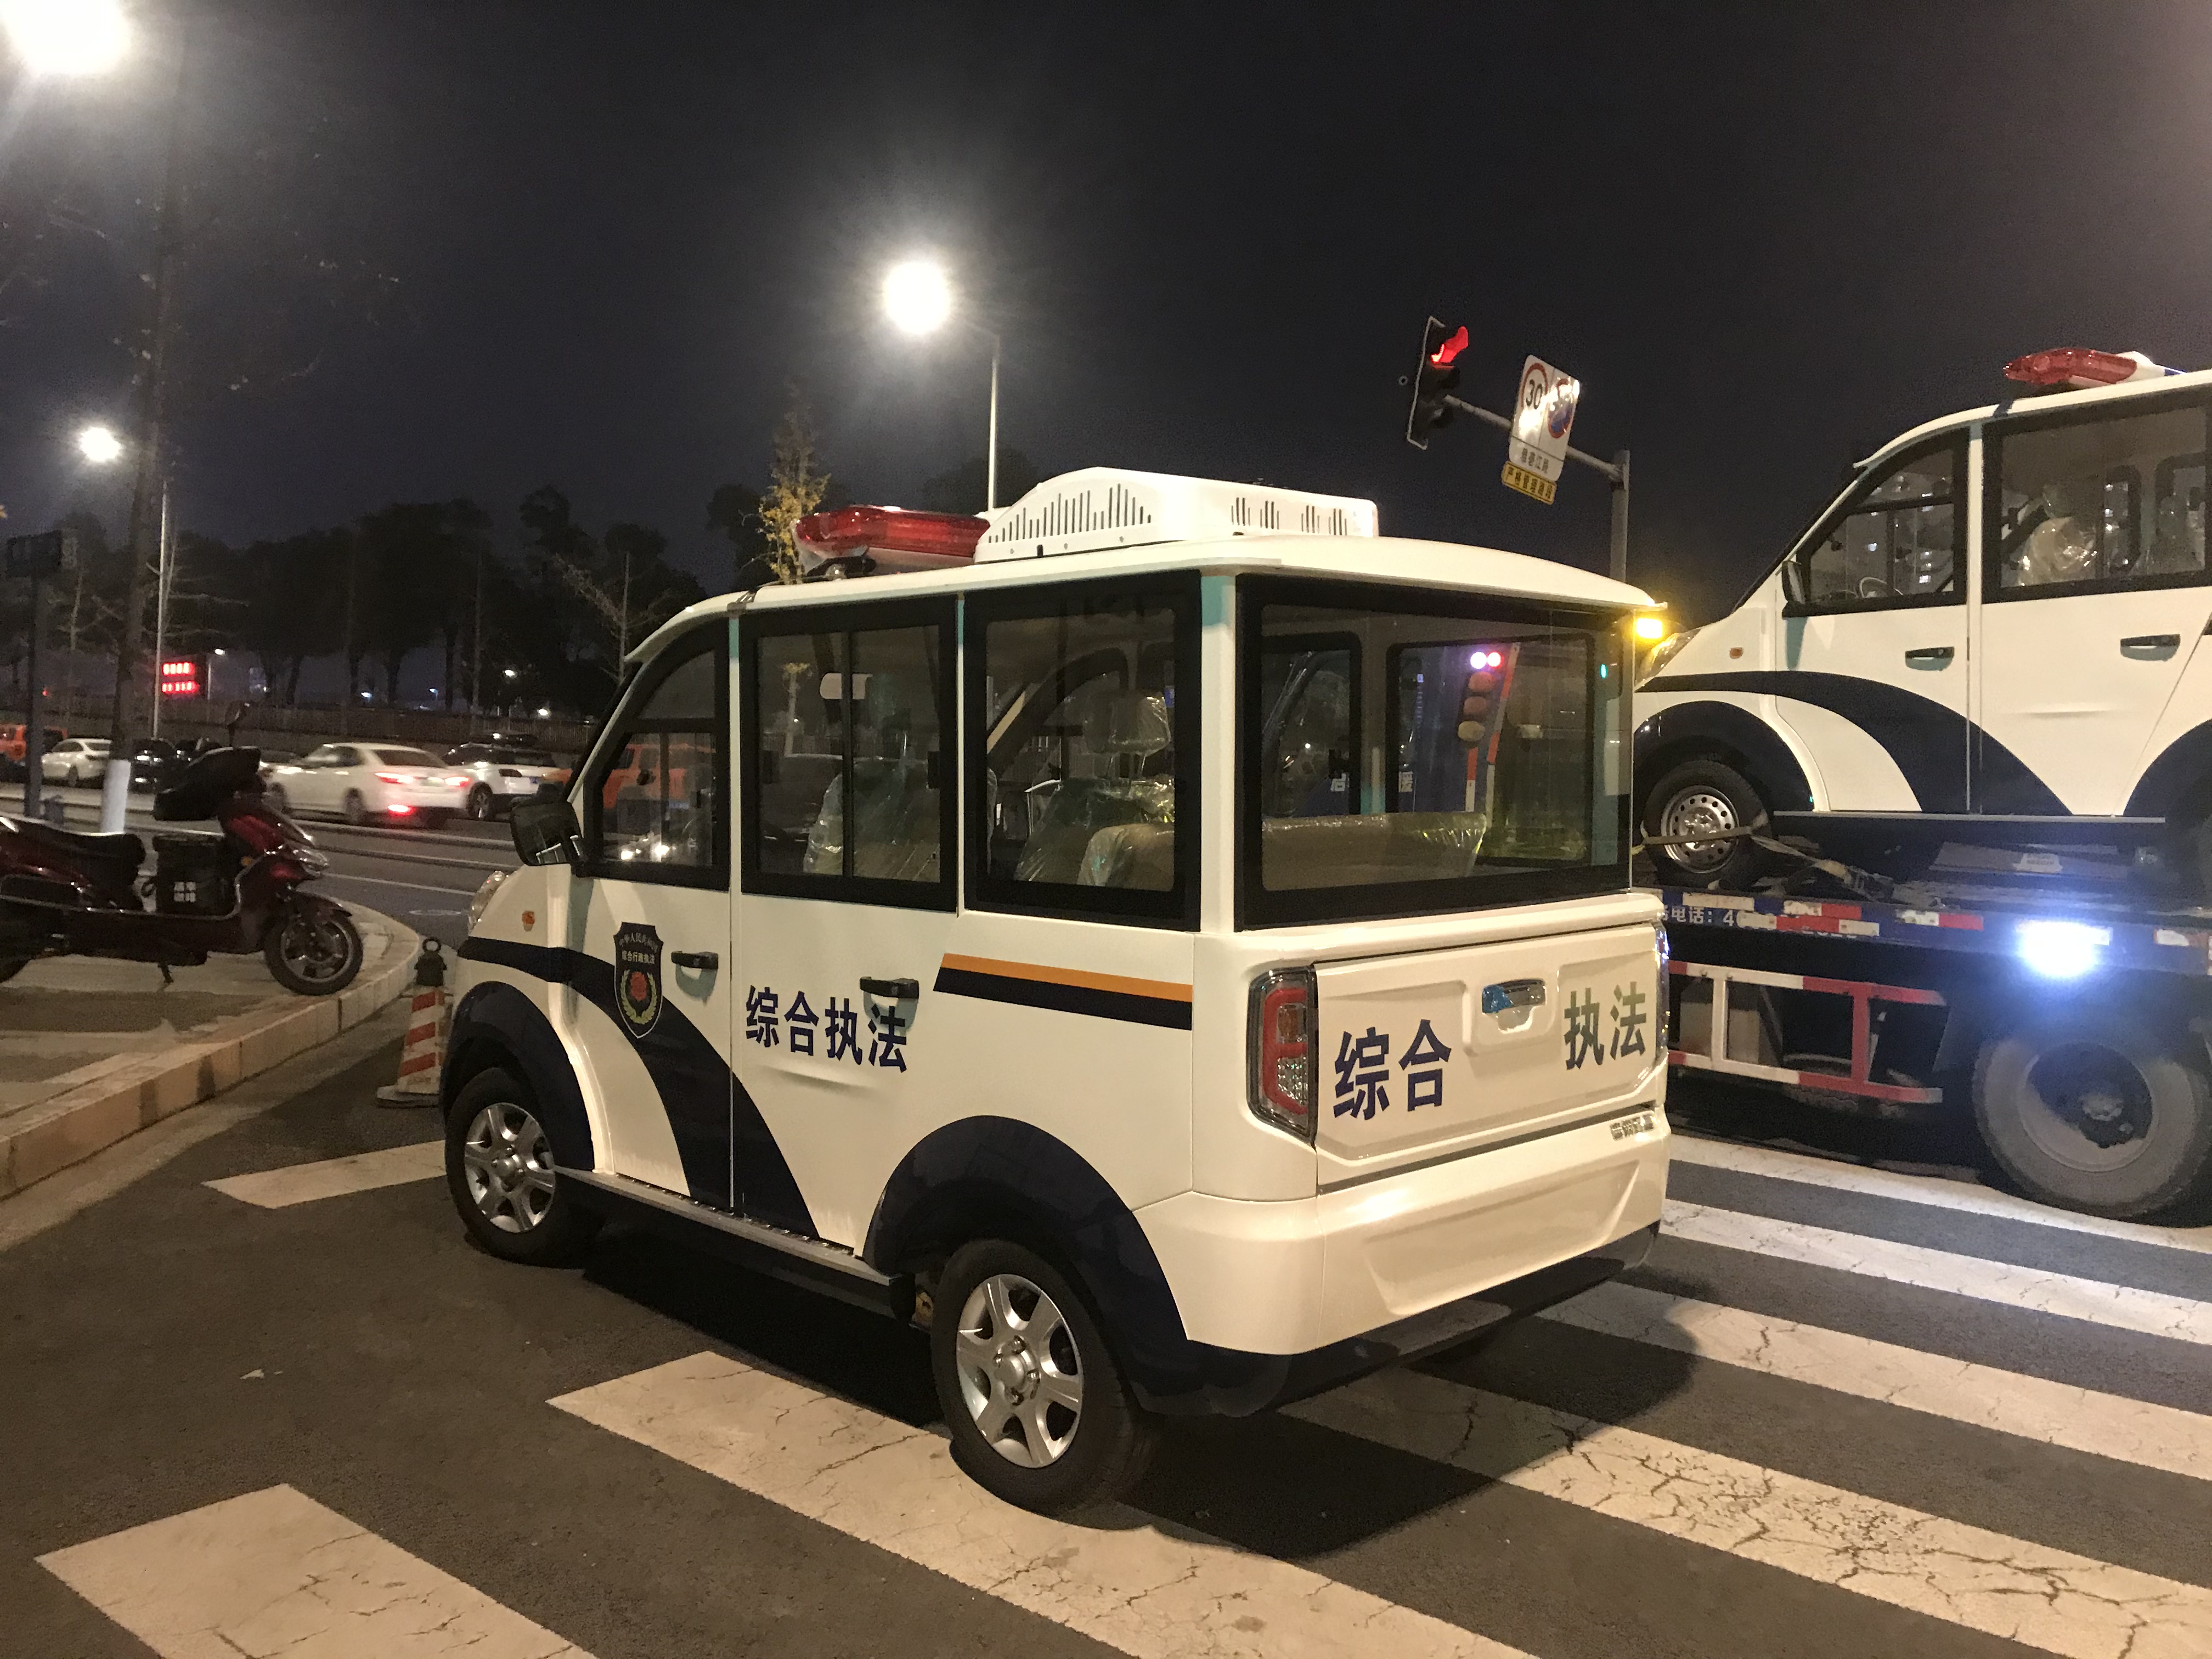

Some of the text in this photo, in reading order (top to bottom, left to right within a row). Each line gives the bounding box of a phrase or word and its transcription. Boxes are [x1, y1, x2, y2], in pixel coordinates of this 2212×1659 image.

[1526, 379, 1543, 410] 30
[622, 950, 655, 964] 综合行政执法
[746, 985, 907, 1073] 综合执法
[1333, 981, 1646, 1120] 综合 执法
